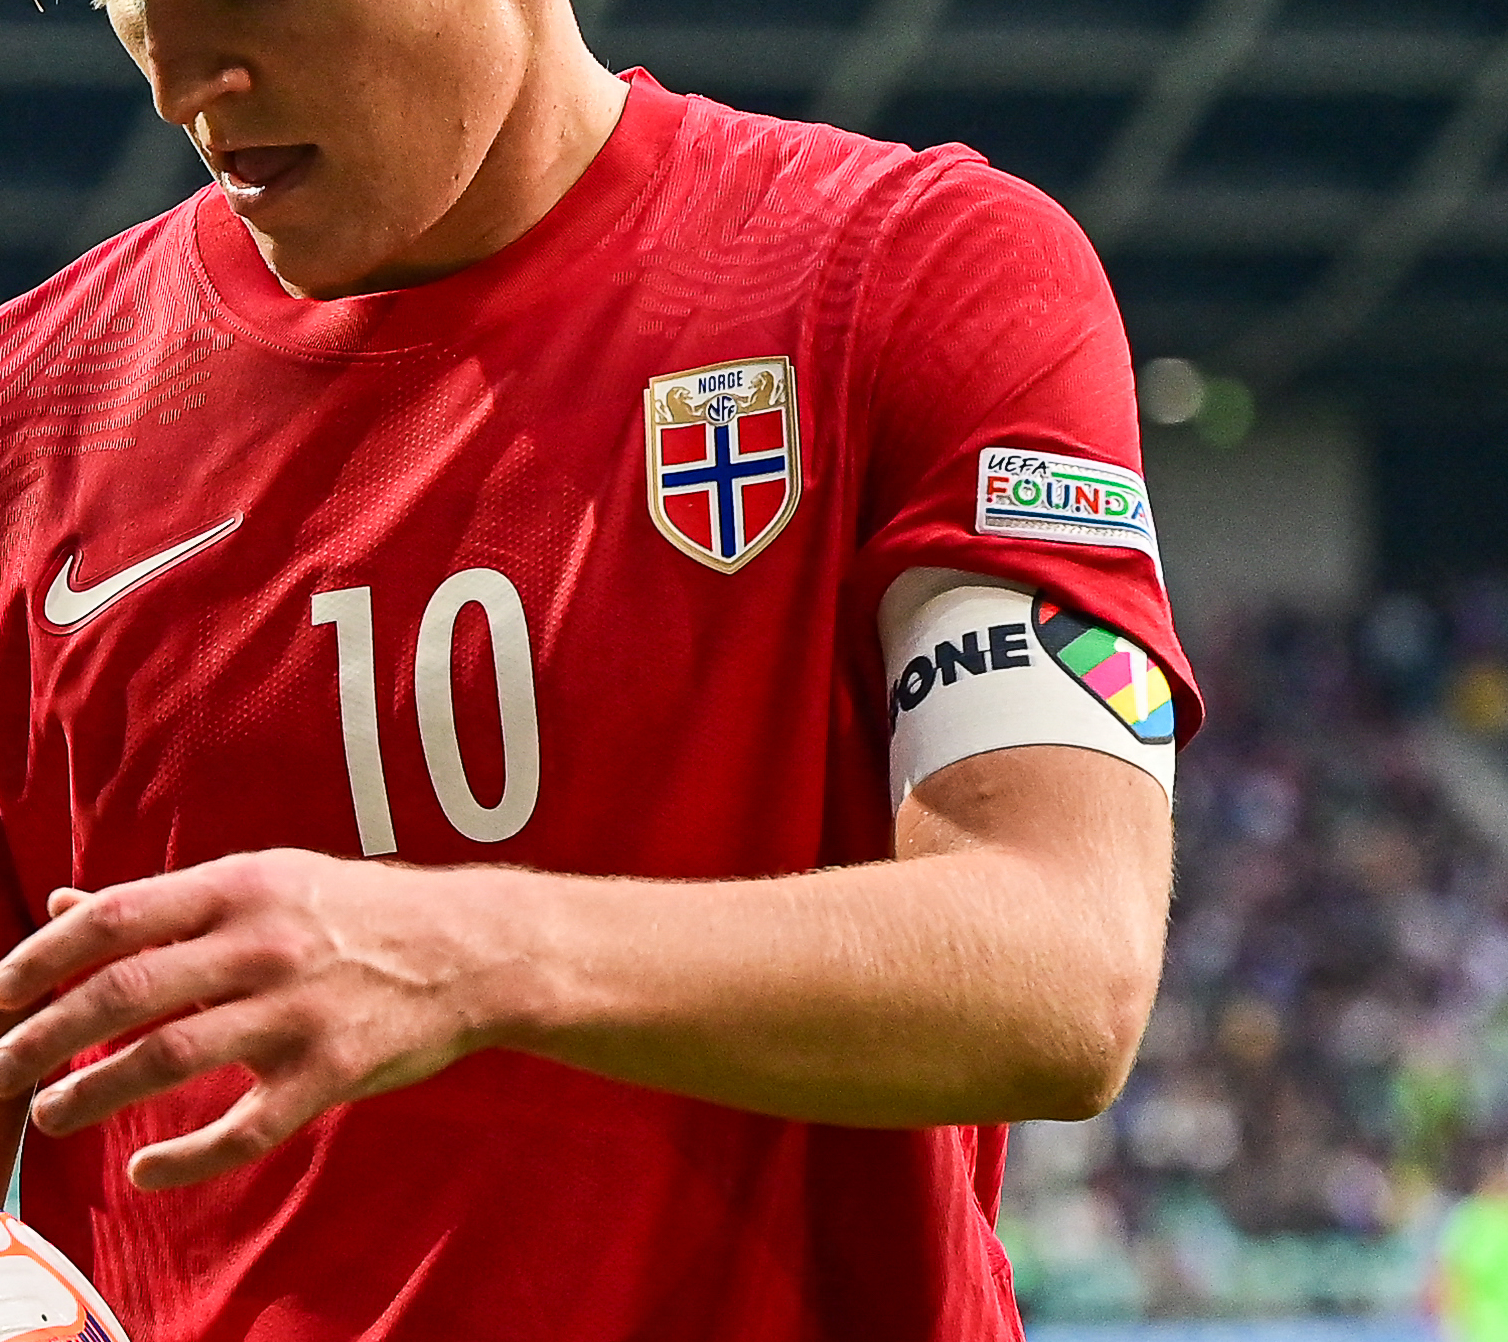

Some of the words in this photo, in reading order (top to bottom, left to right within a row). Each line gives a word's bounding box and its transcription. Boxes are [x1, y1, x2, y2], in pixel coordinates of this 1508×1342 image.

[698, 369, 744, 395] NORGE
[987, 453, 1050, 475] UEFA
[310, 567, 541, 857] 10
